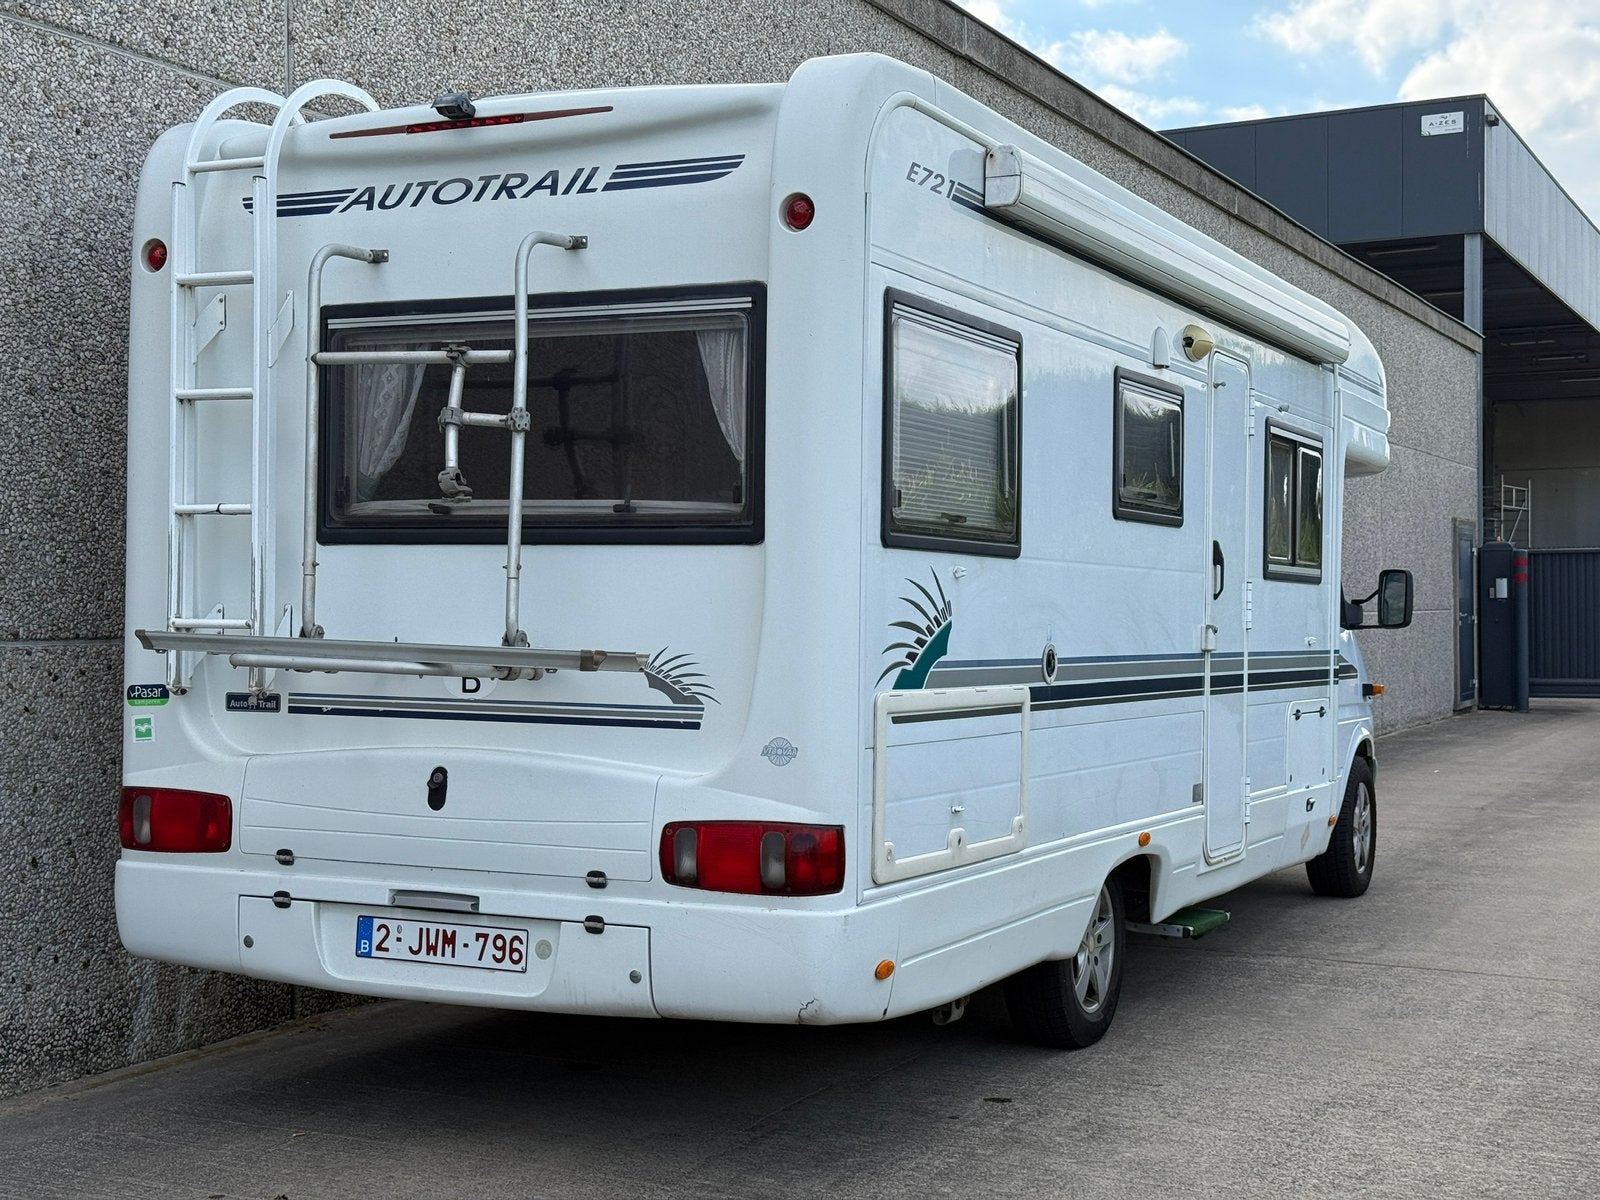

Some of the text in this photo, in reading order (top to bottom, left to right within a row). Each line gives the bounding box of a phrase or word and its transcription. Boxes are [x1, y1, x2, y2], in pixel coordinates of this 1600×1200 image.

[905, 161, 956, 199] E721
[339, 167, 604, 213] AUTOTRAIL
[133, 685, 163, 698] Pasar
[229, 700, 277, 709] Auto Trail
[360, 940, 370, 953] B
